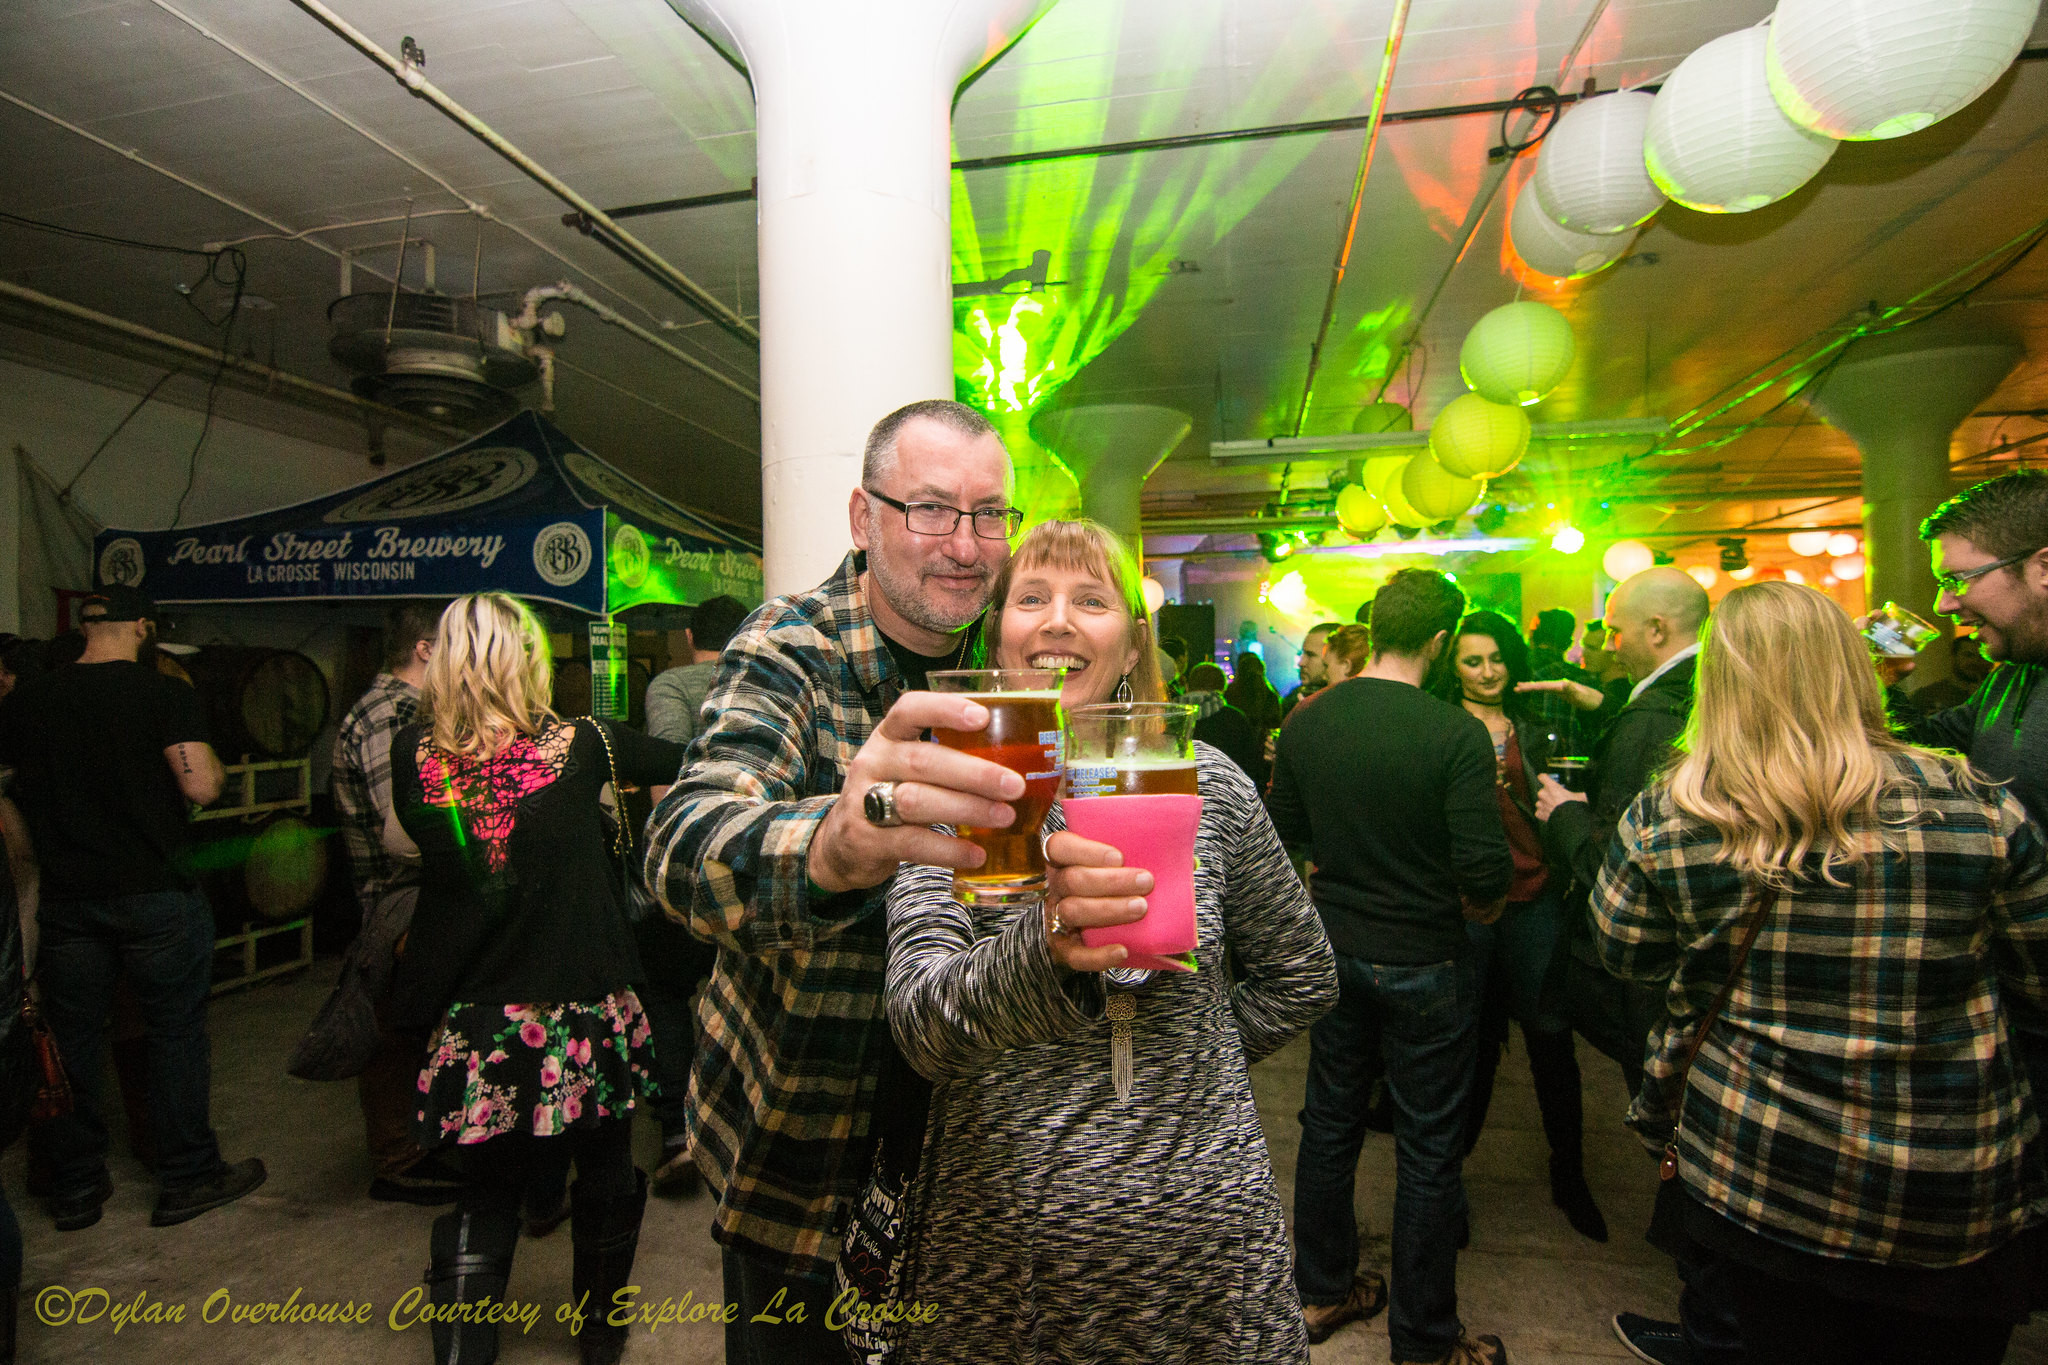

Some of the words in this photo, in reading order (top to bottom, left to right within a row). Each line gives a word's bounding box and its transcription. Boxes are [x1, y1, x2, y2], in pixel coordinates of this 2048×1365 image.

[168, 535, 254, 565] Pearl
[264, 531, 353, 561] Street
[367, 526, 506, 568] Brewery
[247, 565, 263, 584] LA
[267, 563, 321, 583] CROSSE
[333, 561, 415, 581] WISCONSIN
[1076, 767, 1118, 780] RELEASES
